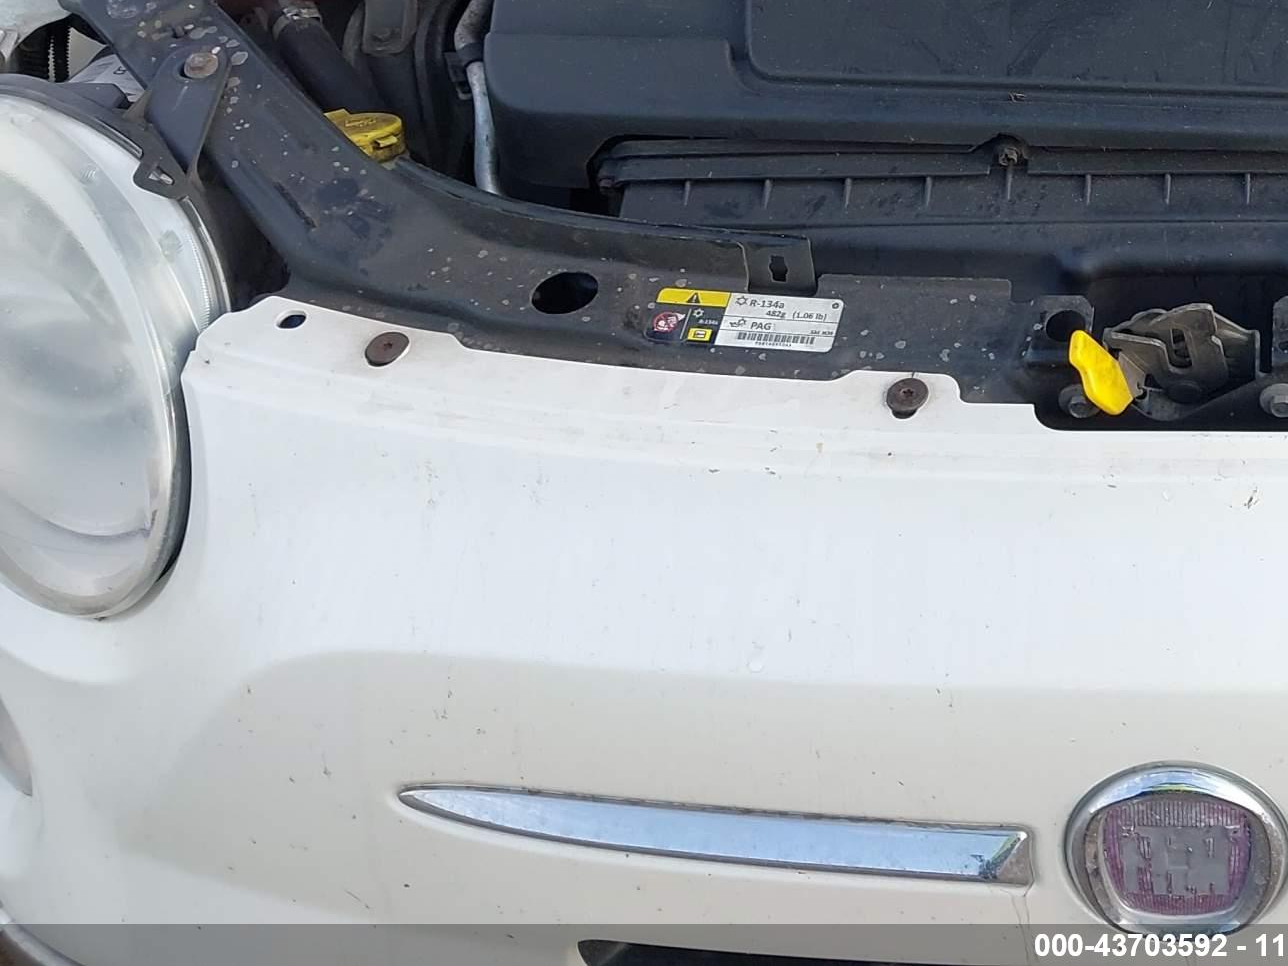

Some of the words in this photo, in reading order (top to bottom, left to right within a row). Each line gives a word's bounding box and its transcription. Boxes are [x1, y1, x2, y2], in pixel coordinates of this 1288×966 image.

[749, 299, 785, 310] R-134a
[766, 310, 787, 319] 482g
[792, 310, 814, 321] (1.06
[814, 312, 827, 322] lb)
[750, 321, 772, 331] PAG
